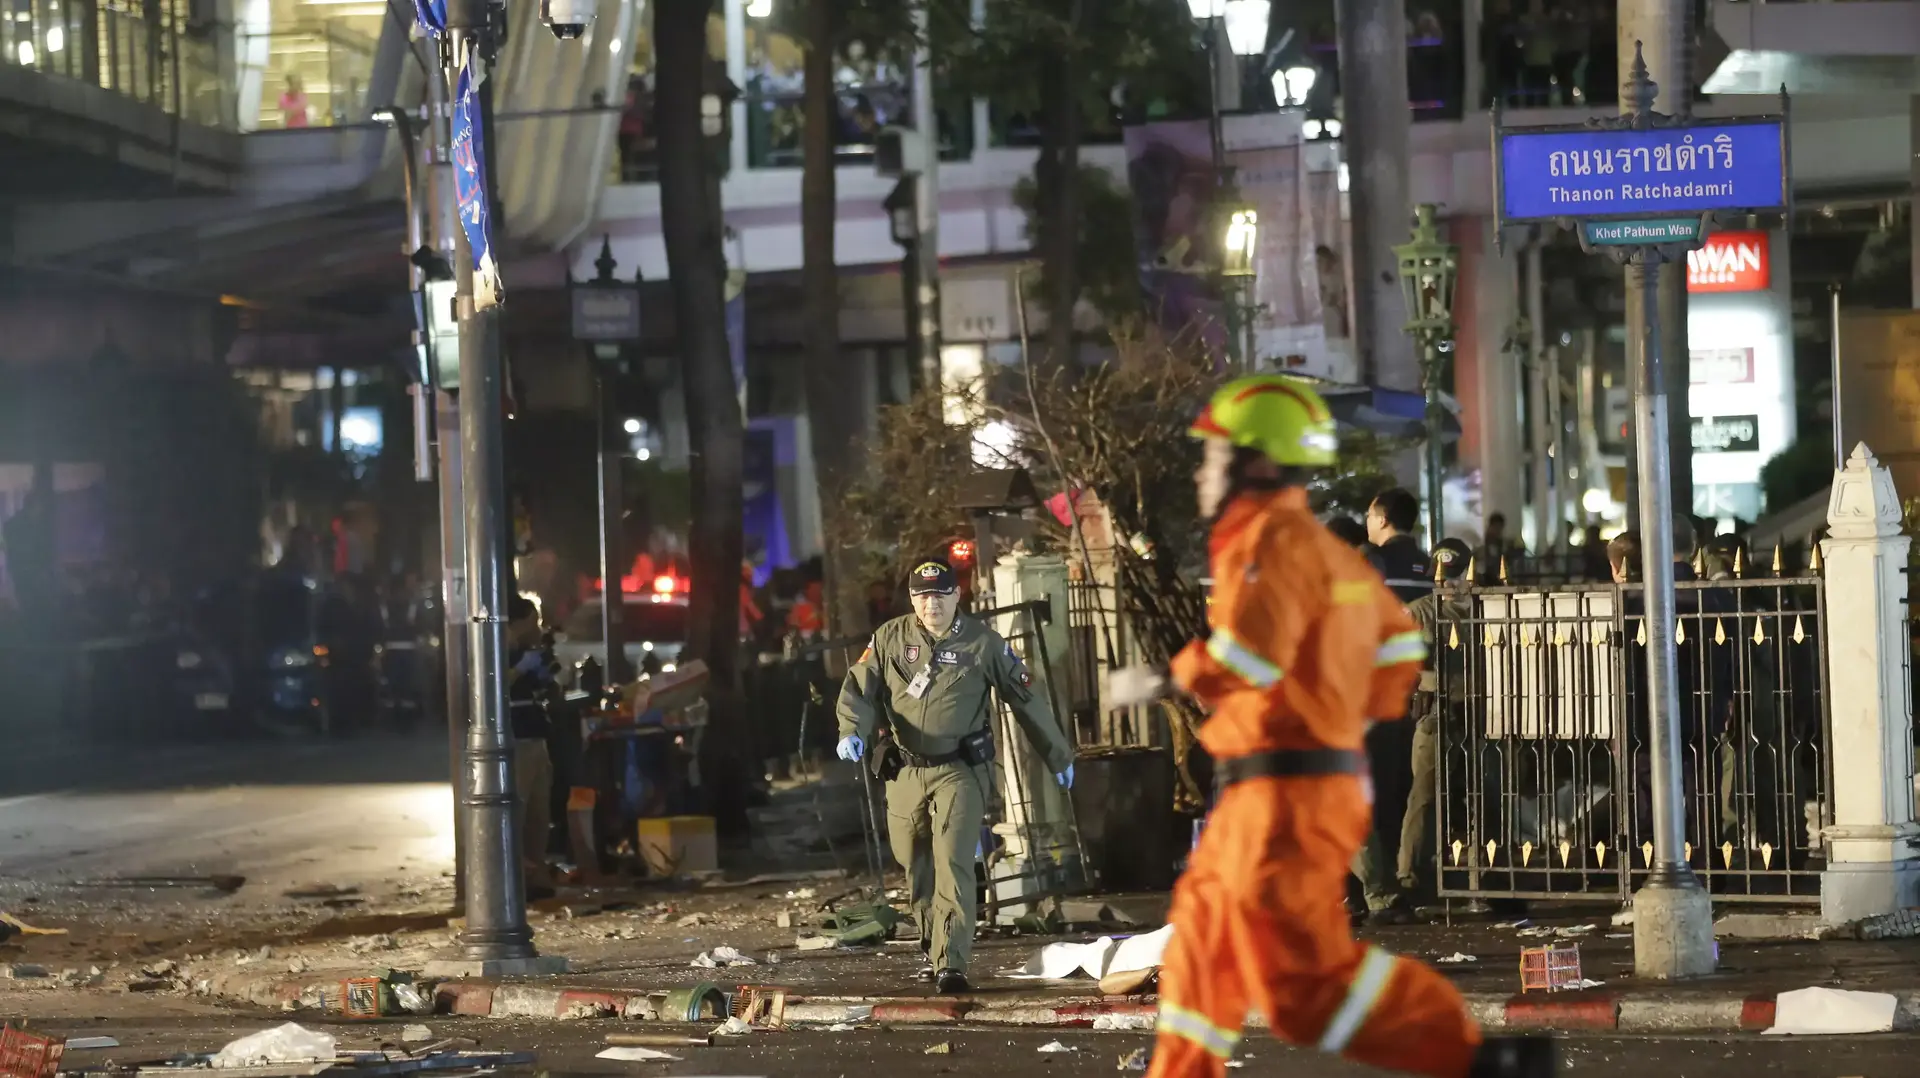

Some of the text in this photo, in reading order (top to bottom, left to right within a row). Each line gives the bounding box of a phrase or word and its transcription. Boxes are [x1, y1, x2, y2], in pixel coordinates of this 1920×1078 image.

[1549, 133, 1733, 176] ถนนราชดำริ
[1549, 180, 1733, 203] Thanon Ratchadamri
[1596, 224, 1692, 239] Khet Pathum Wan
